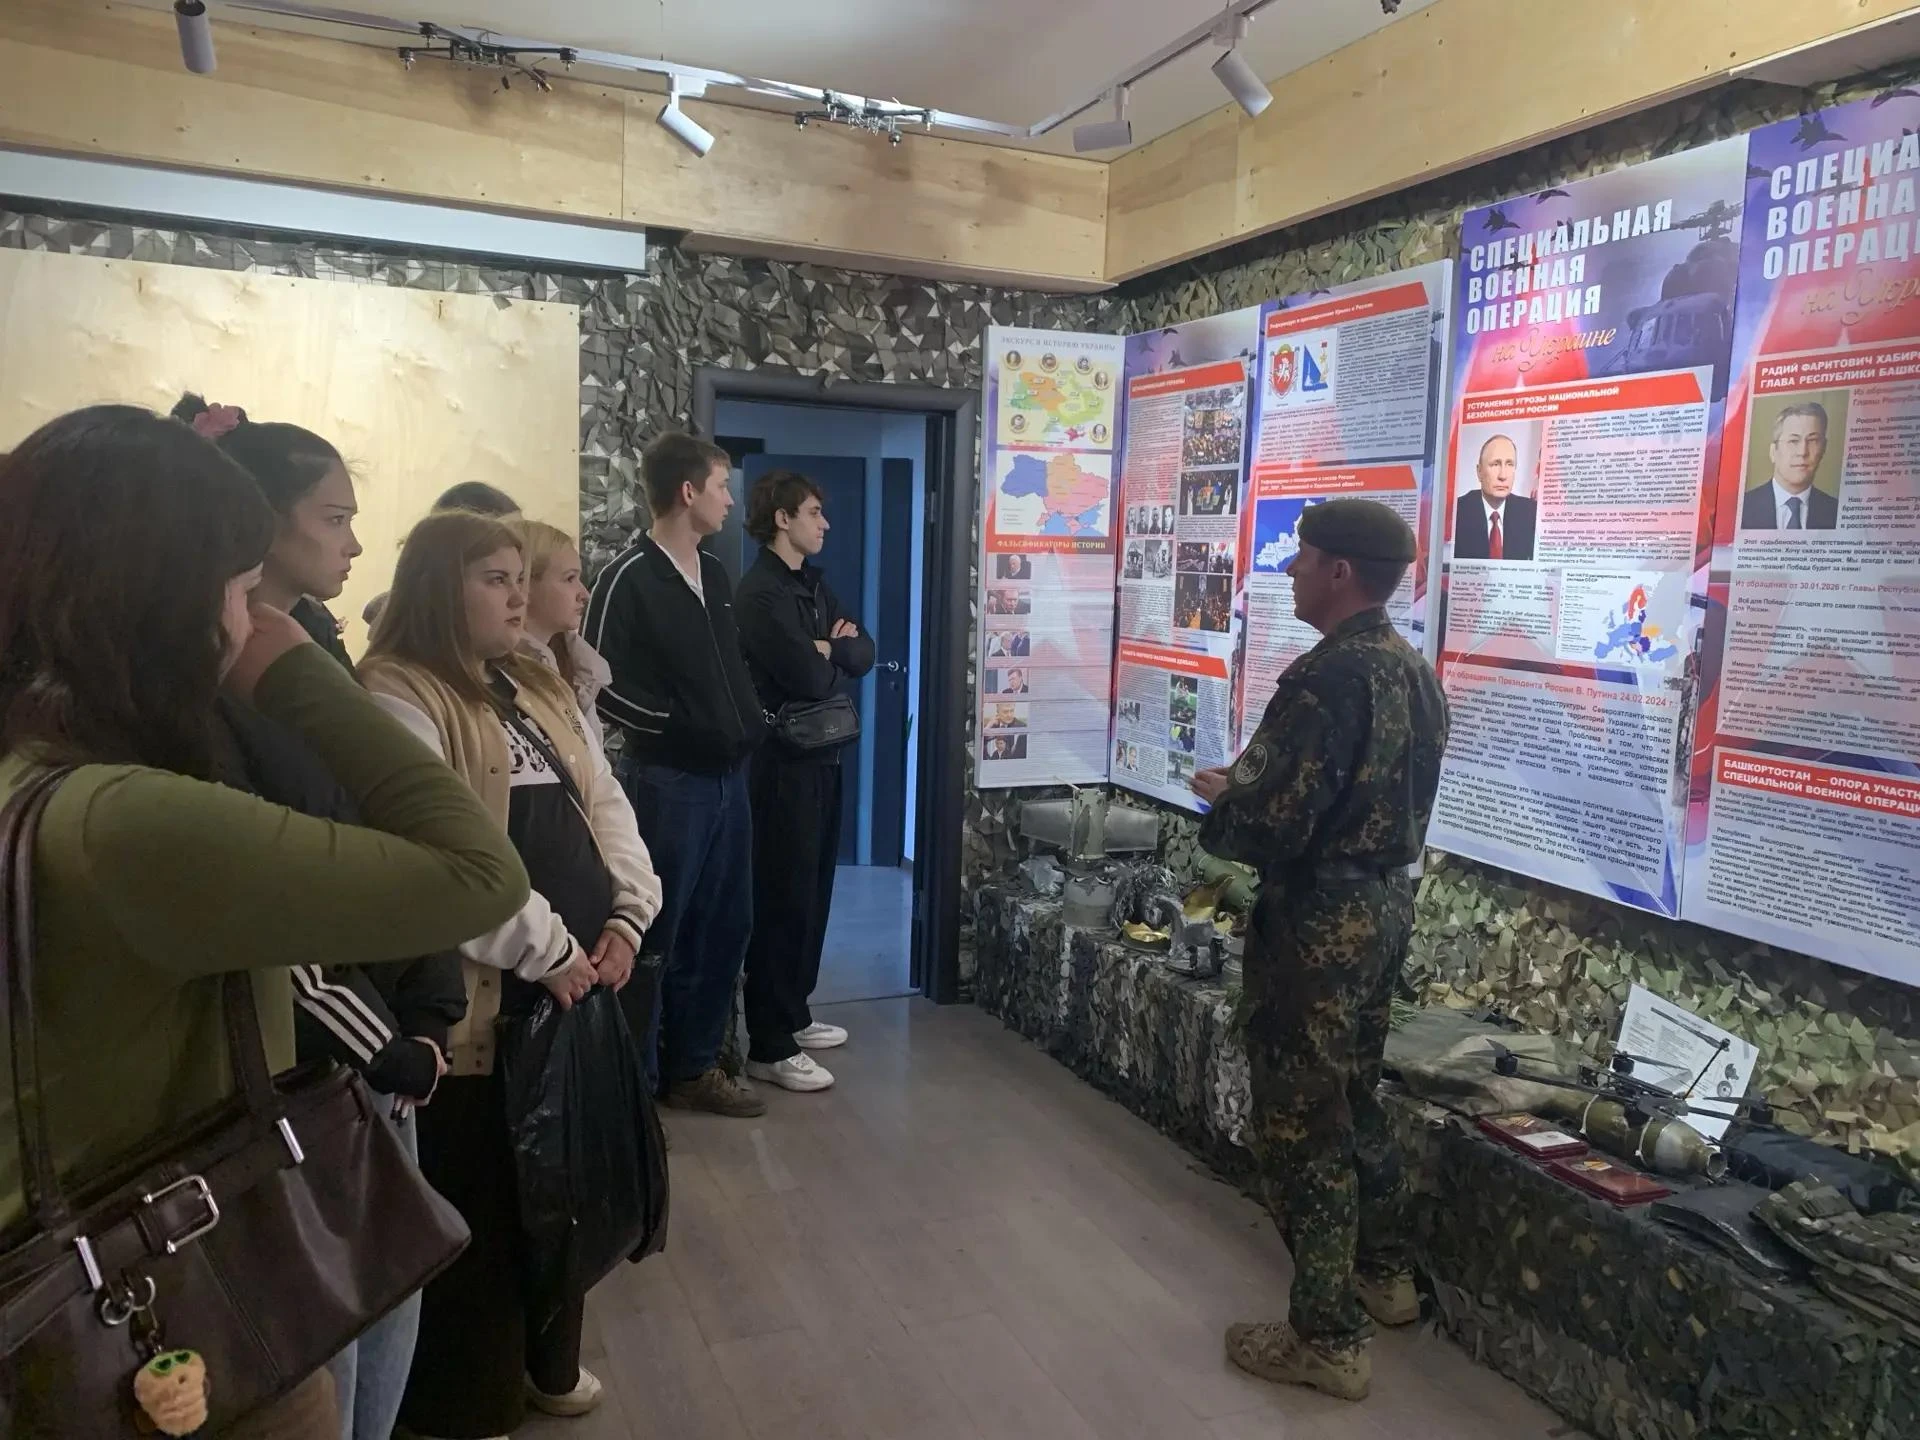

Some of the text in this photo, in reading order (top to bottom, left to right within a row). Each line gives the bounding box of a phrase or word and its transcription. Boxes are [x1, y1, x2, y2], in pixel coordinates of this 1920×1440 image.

[1767, 177, 1916, 241] ВОЕННА
[1470, 199, 1672, 272] СПЕЦИАЛЬНАЯ
[1468, 254, 1585, 304] ВОЕННАЯ
[1467, 285, 1601, 334] ОПЕРАЦИЯ
[1761, 350, 1919, 377] РАДИЙ ФАРИТОВИЧ ХАБИР
[1759, 376, 1795, 389] ГЛАВА
[1799, 367, 1875, 386] РЕСПУБЛИКИ
[1467, 386, 1619, 409] УСТРАНЕНИЕ УГРОЗЫ НАЦИОНАЛЬНОЙ
[1466, 403, 1558, 419] БЕЗОПАСНОСТИ РОССИИ
[997, 540, 1106, 549] ФАЛЬСИФИКАТОРЫ ИСТОРИИ
[1498, 676, 1542, 690] Президента
[1544, 682, 1573, 693] России
[1587, 688, 1617, 701] Путина
[1620, 692, 1665, 707] 24.02.2024
[1532, 696, 1586, 712] инфраструктуры
[1592, 705, 1672, 725] Североатлантического
[1607, 718, 1637, 729] Украины
[1568, 730, 1600, 742] Проблема
[1605, 727, 1625, 736] НАТО
[1646, 734, 1670, 744] только
[1619, 750, 1668, 765] исторических
[1639, 763, 1667, 774] которая
[1723, 758, 1811, 781] БАШКОРТОСТАН
[1829, 776, 1870, 791] ОПОРА
[1640, 783, 1665, 794] самым
[1722, 770, 1802, 792] СПЕЦИАЛЬНОЙ
[1805, 784, 1860, 802] ВОЕННОЙ
[1615, 808, 1663, 825] сдерживания
[1609, 826, 1661, 845] исторического
[1629, 821, 1655, 833] страны
[1603, 844, 1659, 865] существованию
[1647, 844, 1660, 854] Это
